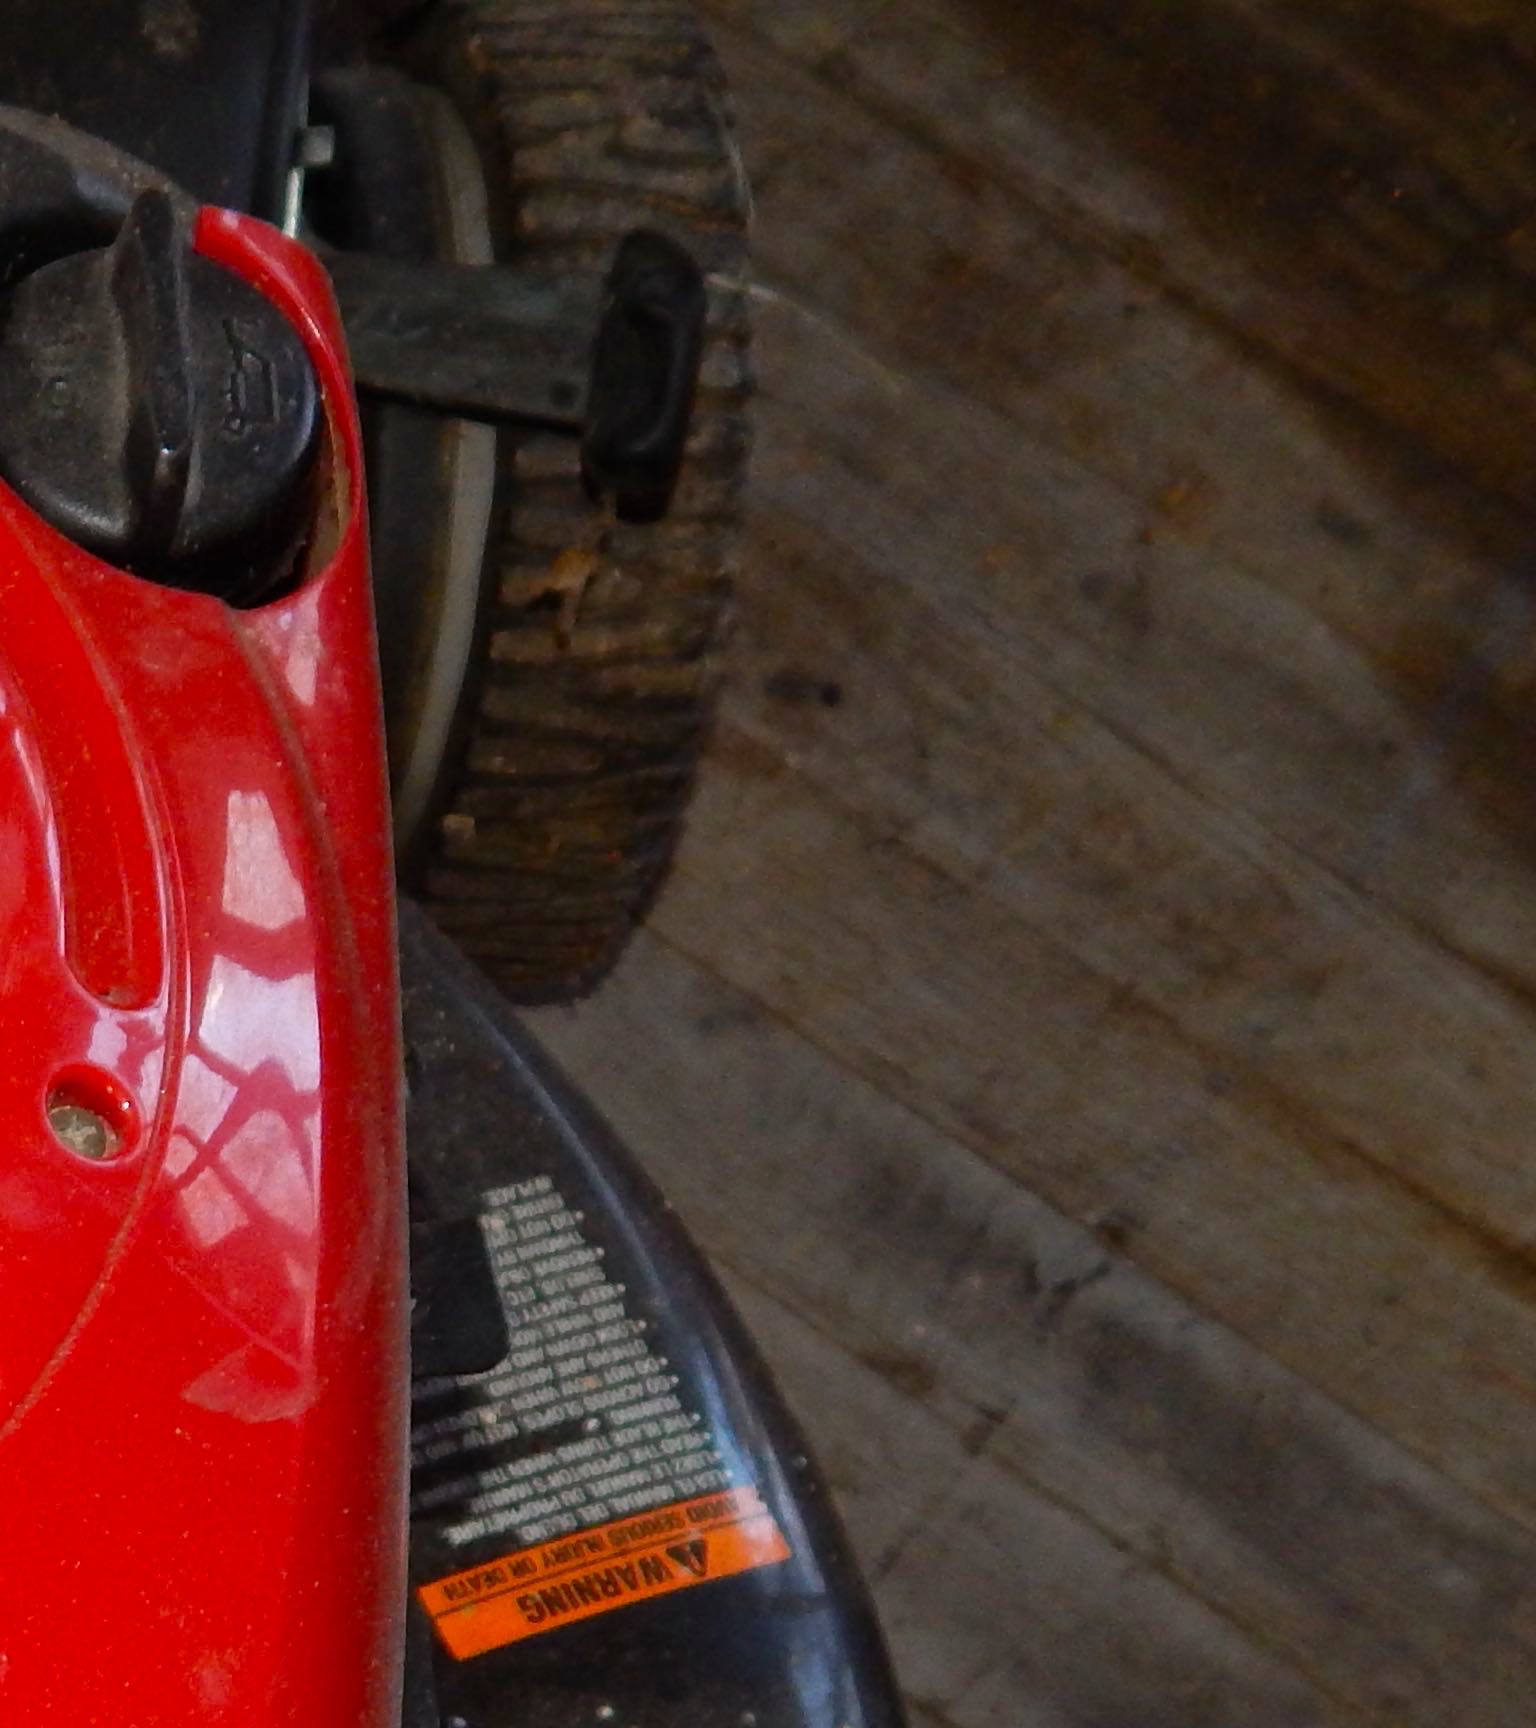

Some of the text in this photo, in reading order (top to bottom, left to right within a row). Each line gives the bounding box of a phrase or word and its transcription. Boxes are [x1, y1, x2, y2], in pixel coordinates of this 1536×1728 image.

[607, 1510, 685, 1548] SERIOUS
[507, 1555, 537, 1580] OR
[541, 1533, 605, 1568] INJURY
[442, 1565, 508, 1601] DEATH
[515, 1551, 674, 1626] WARNING
